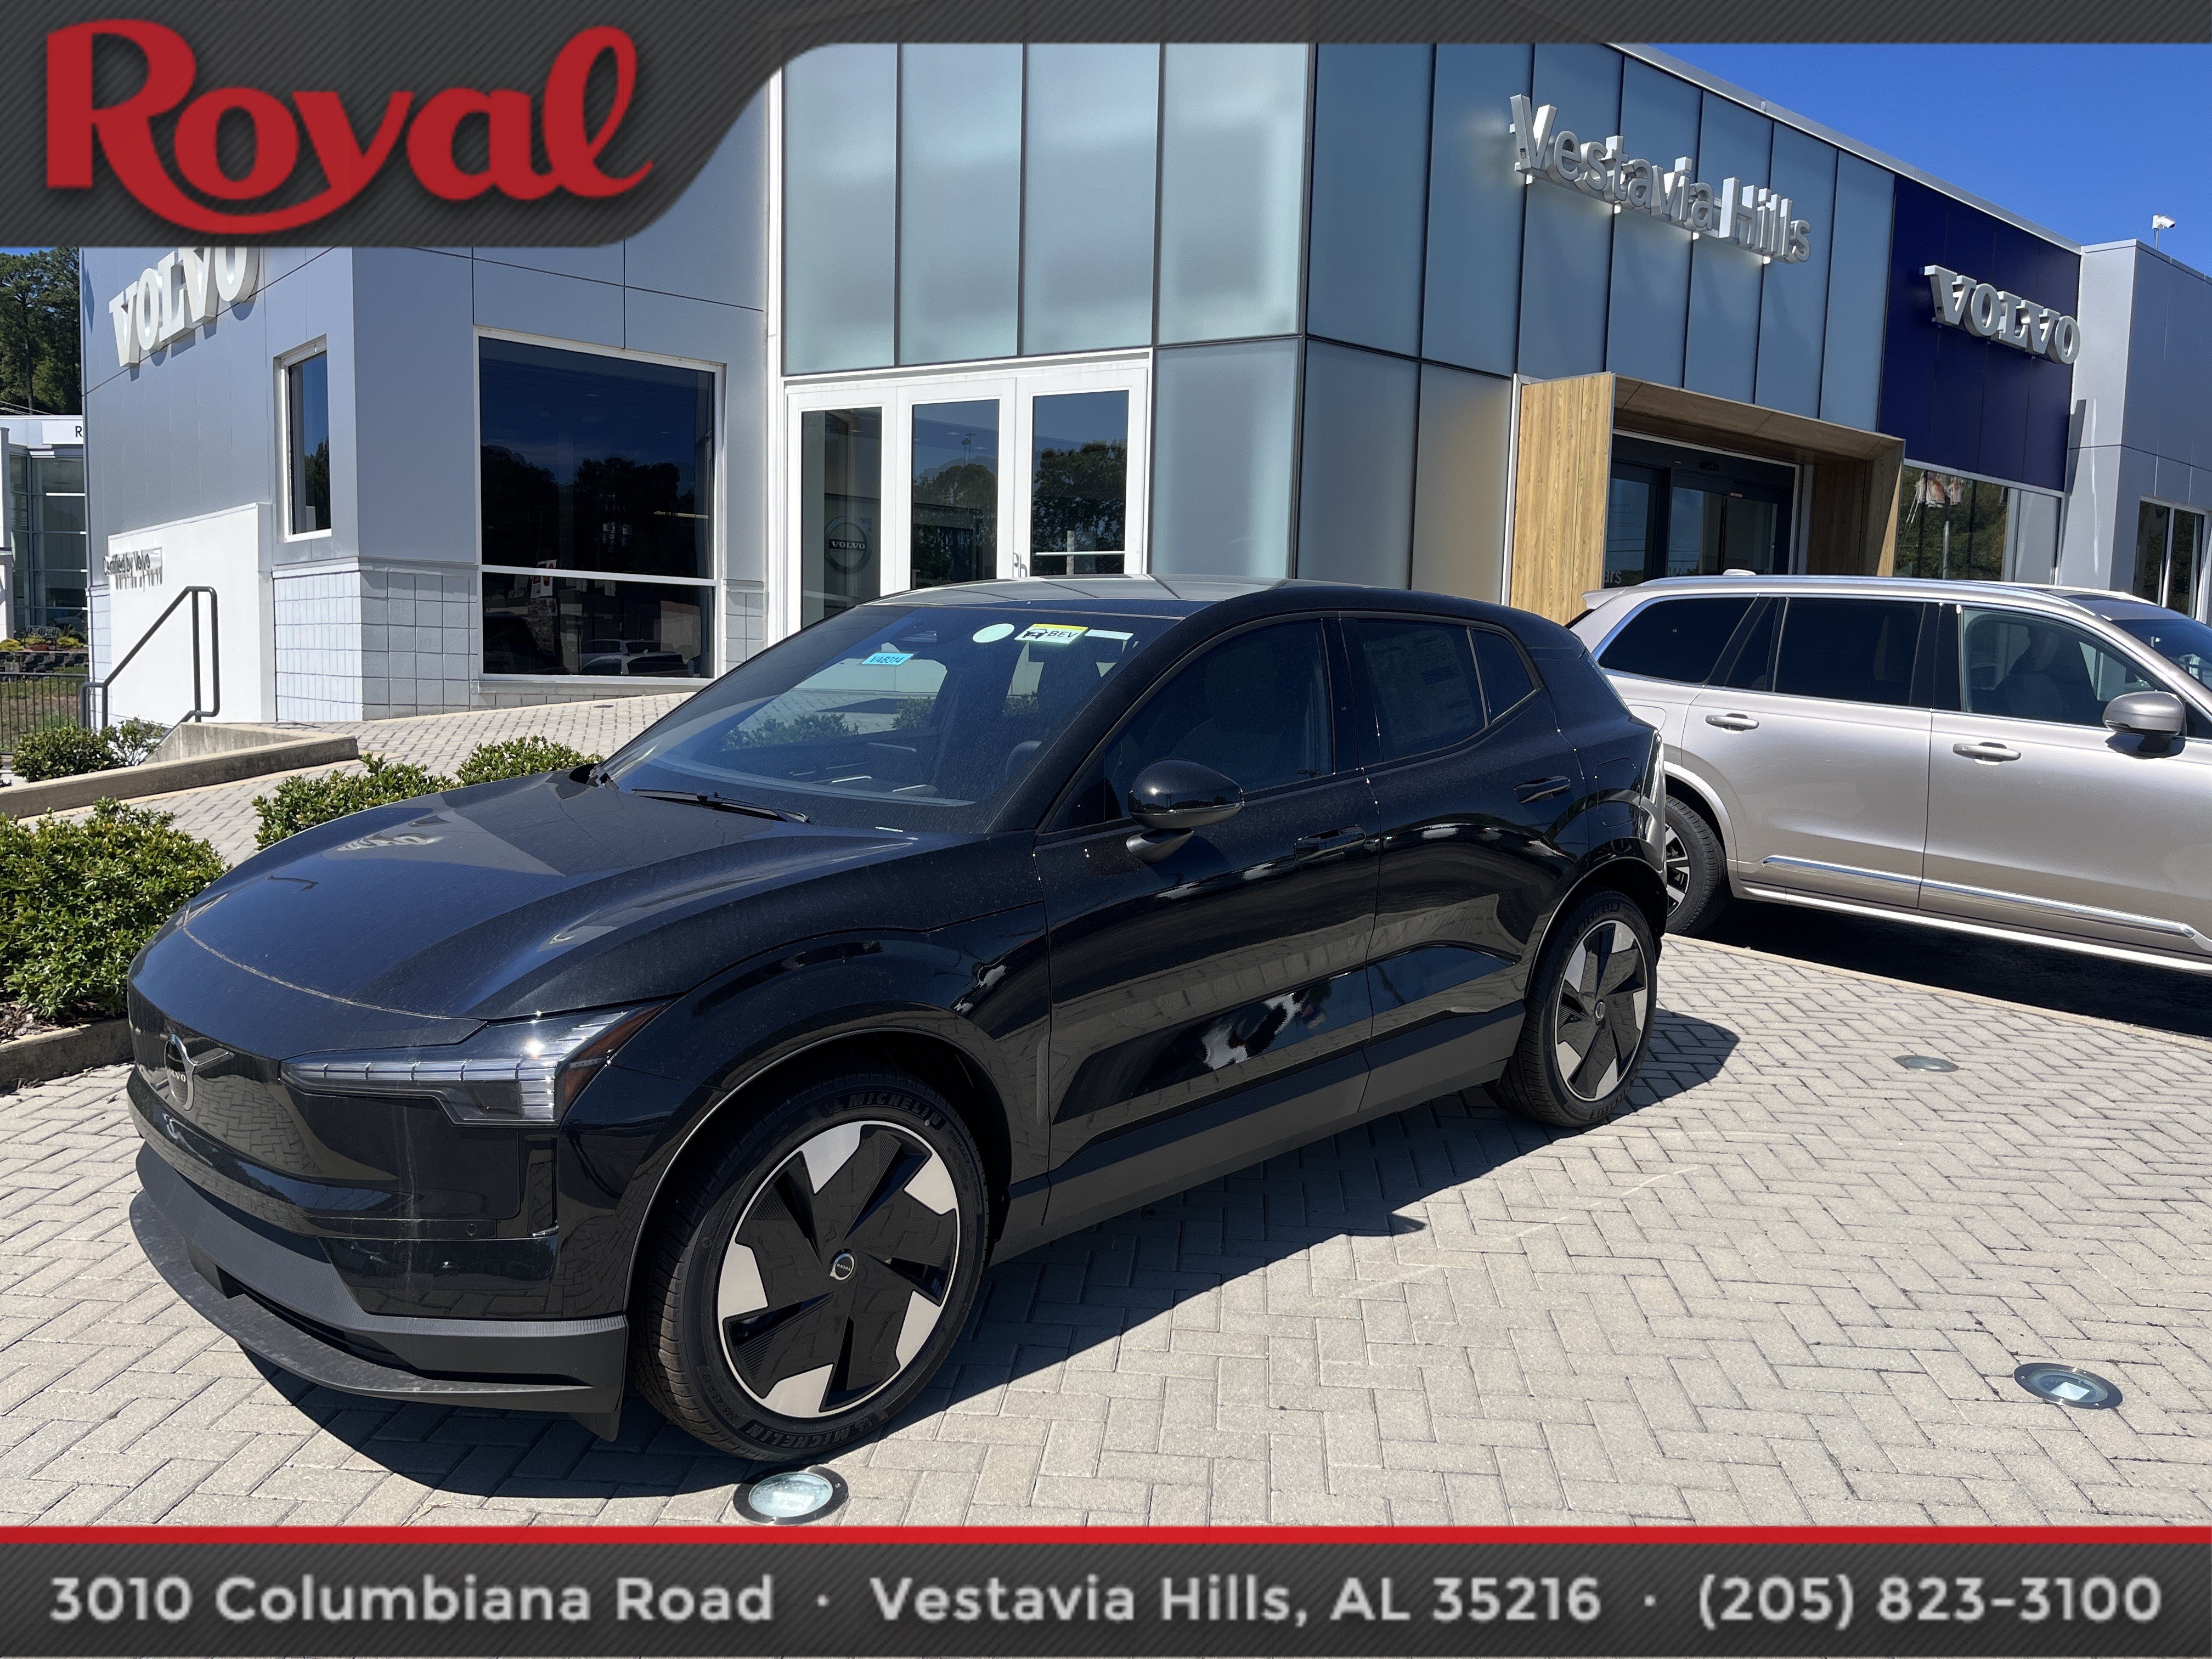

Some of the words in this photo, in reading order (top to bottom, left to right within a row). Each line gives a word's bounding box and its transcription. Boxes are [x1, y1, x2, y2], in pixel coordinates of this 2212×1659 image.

[1510, 94, 1716, 231] Vestavia
[1720, 177, 1811, 264] Hills
[109, 246, 260, 368] VOLVO
[1924, 264, 2081, 364] VOLVO
[831, 540, 866, 550] VOLVO
[1047, 630, 1079, 638] BEV
[848, 1092, 943, 1126] MICHELIN
[949, 1130, 970, 1164] PRIMACY
[836, 1263, 851, 1272] VOLVO
[744, 1423, 851, 1449] MICHELIN
